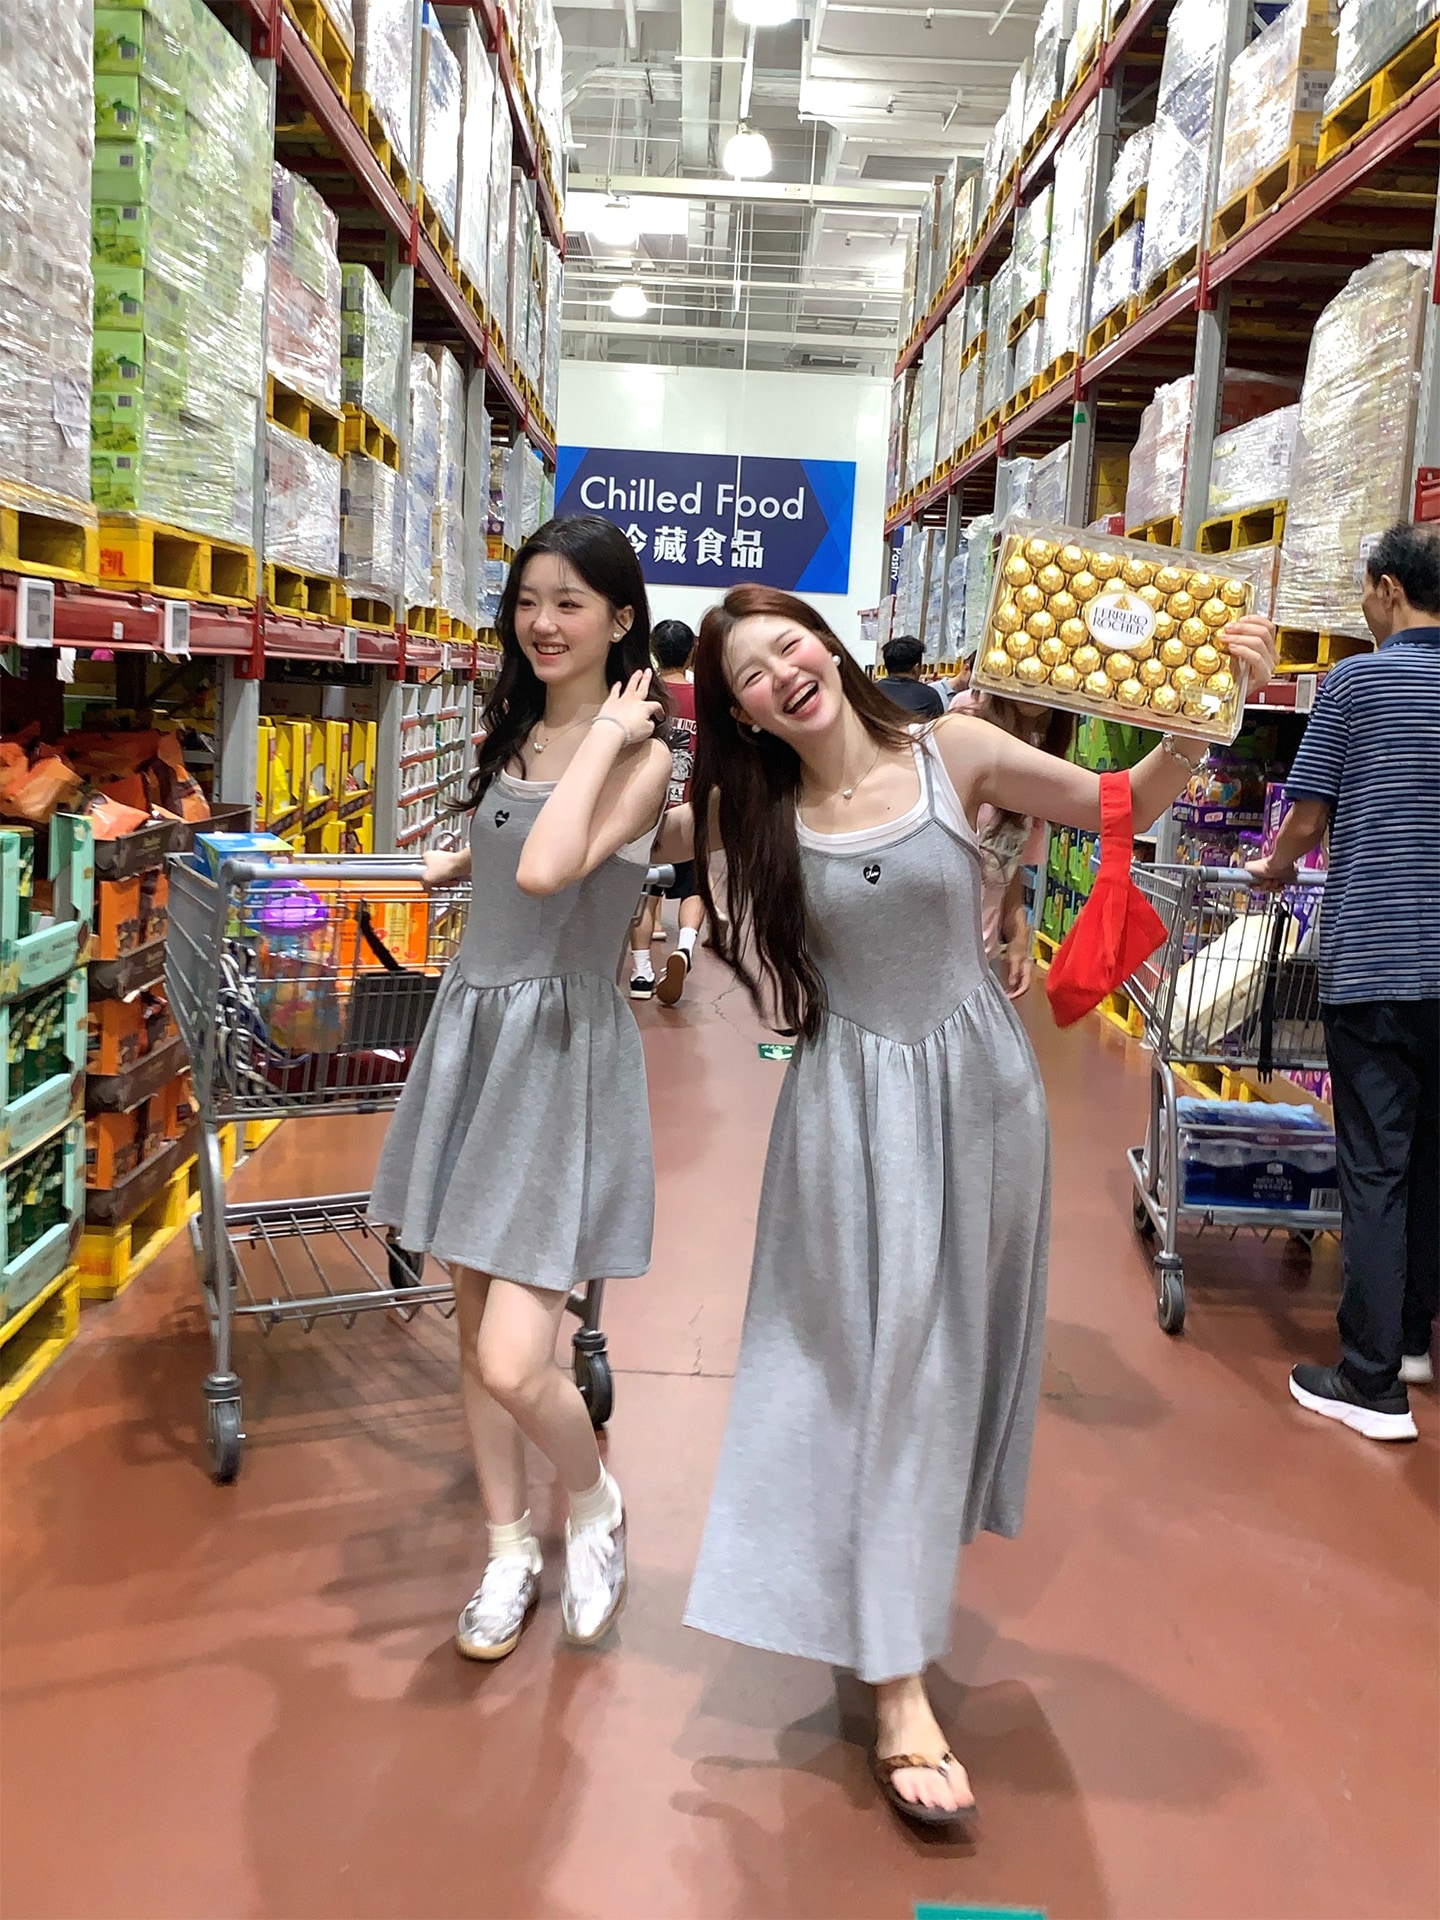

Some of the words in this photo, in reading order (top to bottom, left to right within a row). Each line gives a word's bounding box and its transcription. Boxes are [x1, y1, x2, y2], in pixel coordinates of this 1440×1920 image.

[580, 475, 703, 516] Chilled
[716, 483, 805, 520] Food
[890, 547, 902, 581] Pastry
[1092, 616, 1146, 637] ROCHER
[1094, 606, 1148, 627] FERRERO
